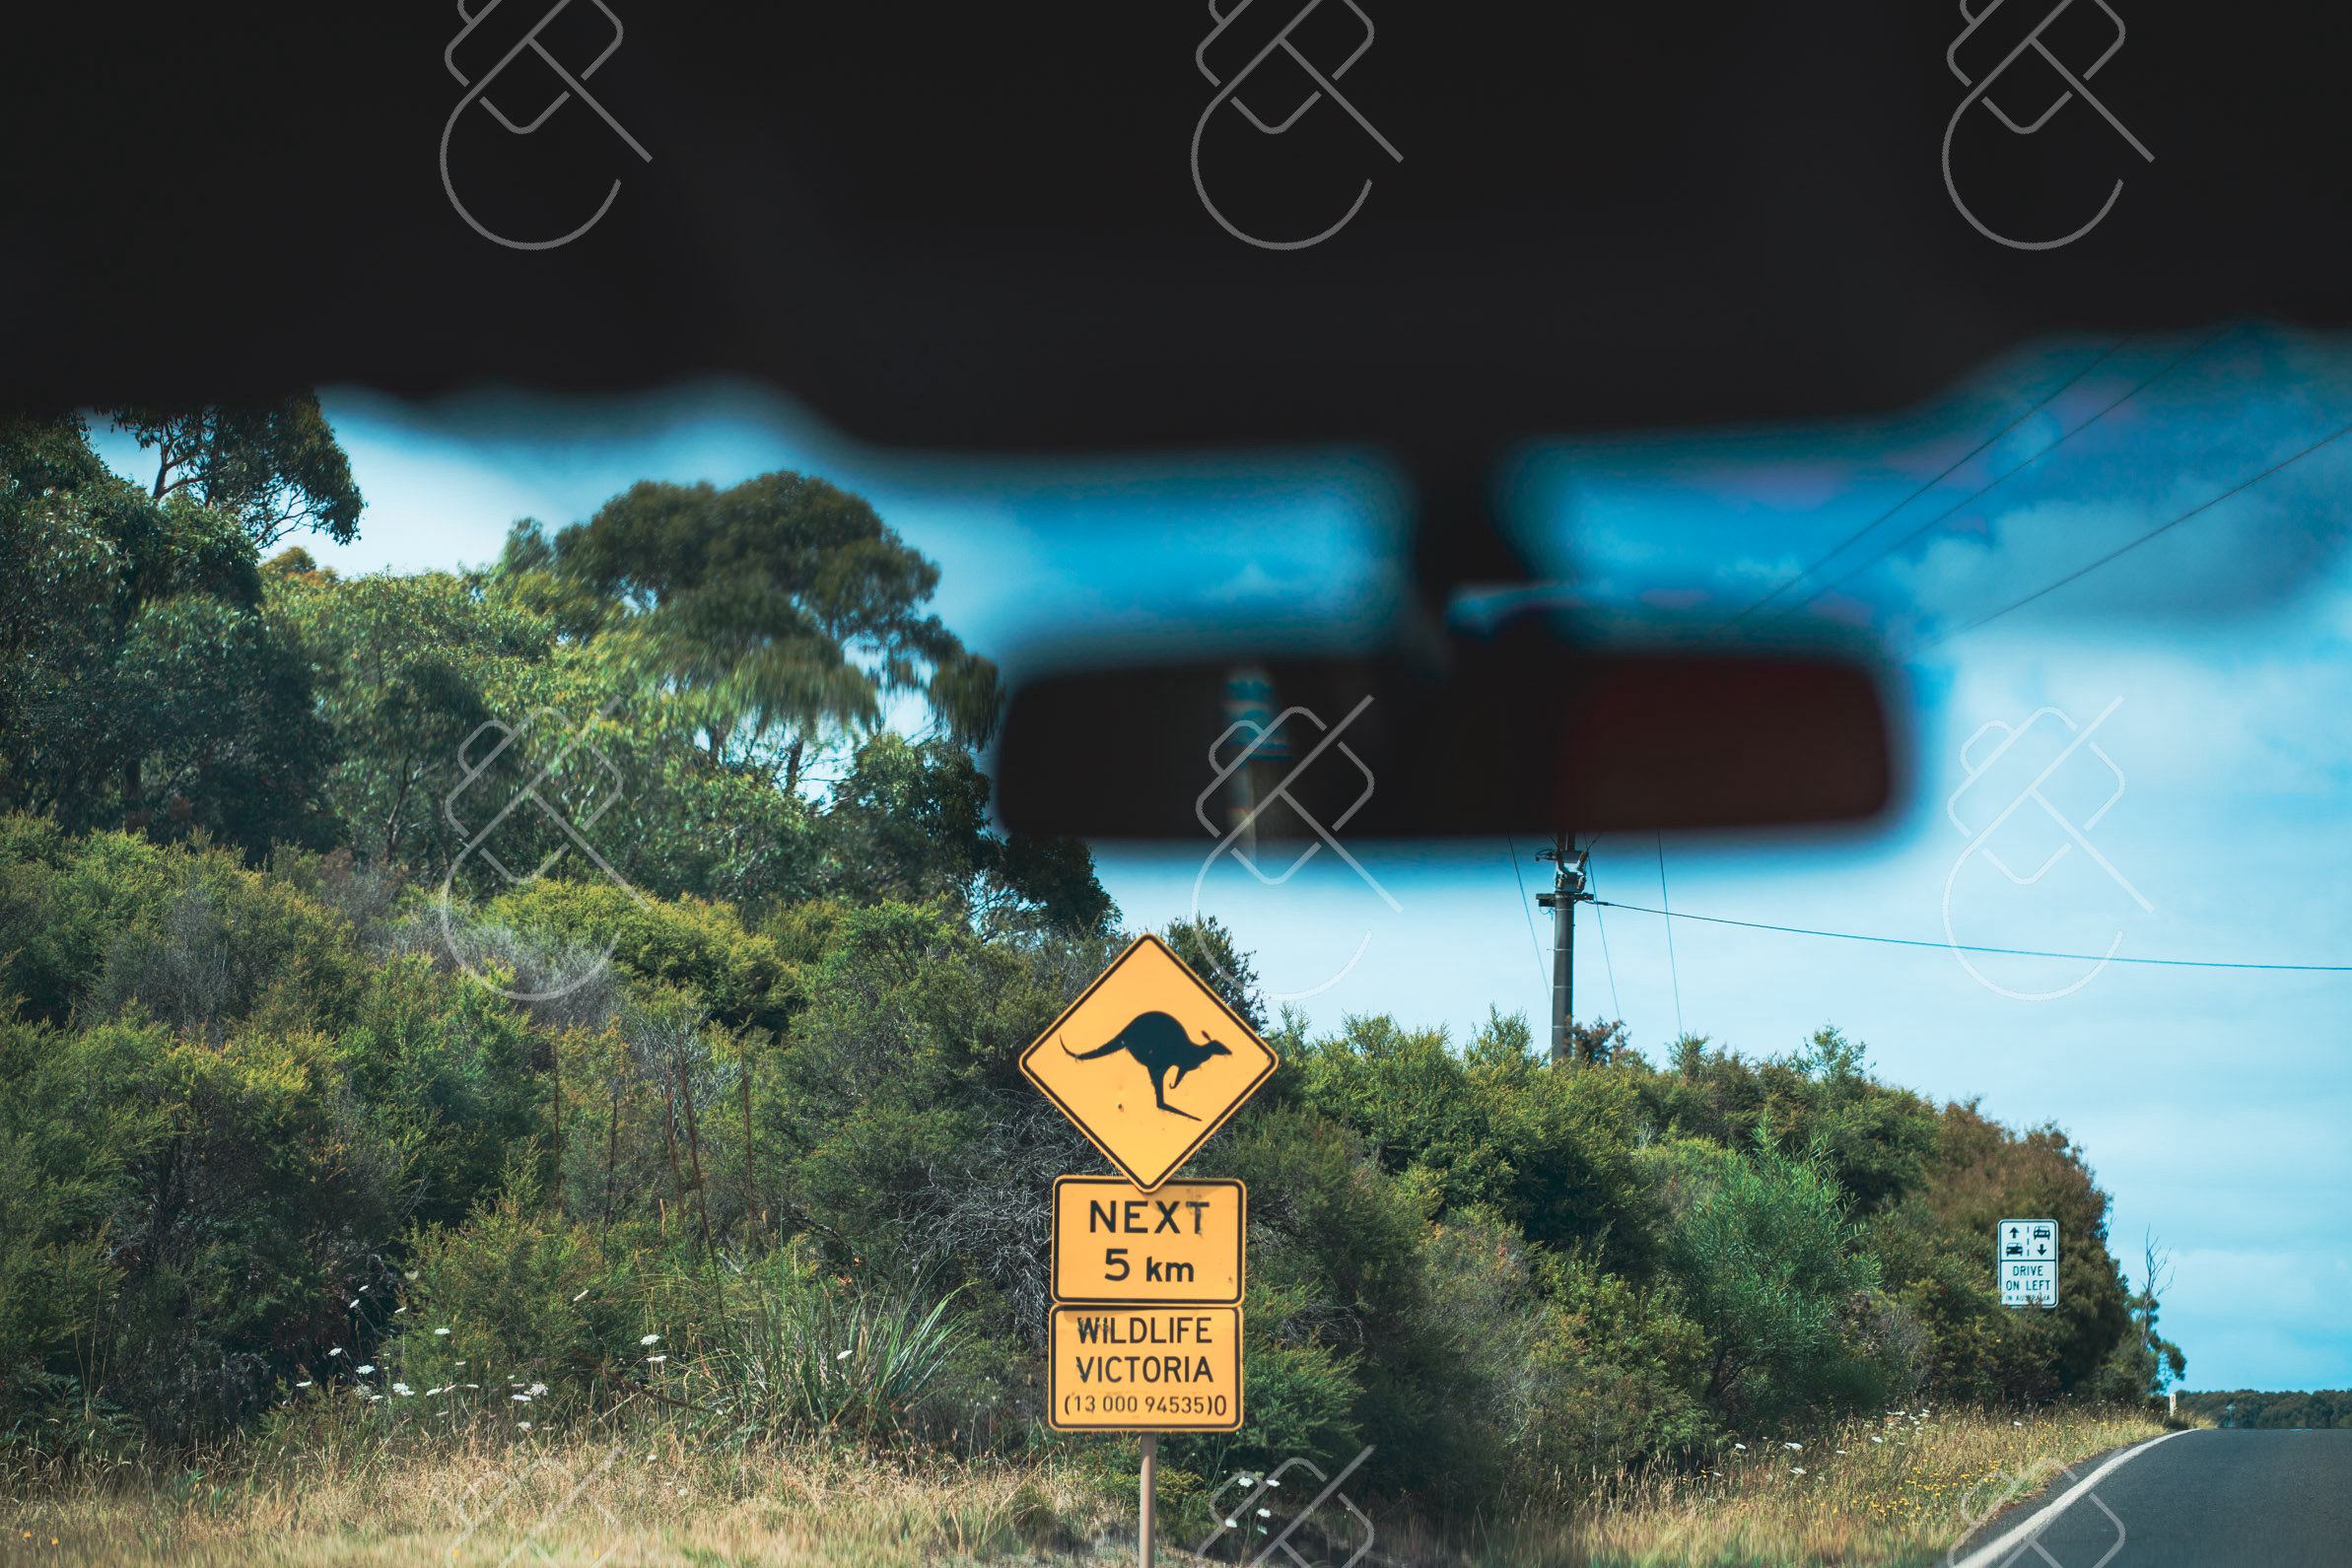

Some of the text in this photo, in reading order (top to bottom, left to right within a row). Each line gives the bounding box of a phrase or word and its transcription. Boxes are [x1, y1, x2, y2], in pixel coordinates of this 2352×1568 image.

[1089, 1199, 1211, 1235] NEXT
[1104, 1248, 1195, 1282] 5 km
[2013, 1265, 2043, 1276] DRIVE
[2006, 1280, 2050, 1291] ON LEFT
[1076, 1317, 1212, 1344] WILDLIFE
[1075, 1356, 1214, 1383] VICTORIA
[1102, 1395, 1138, 1412] 000
